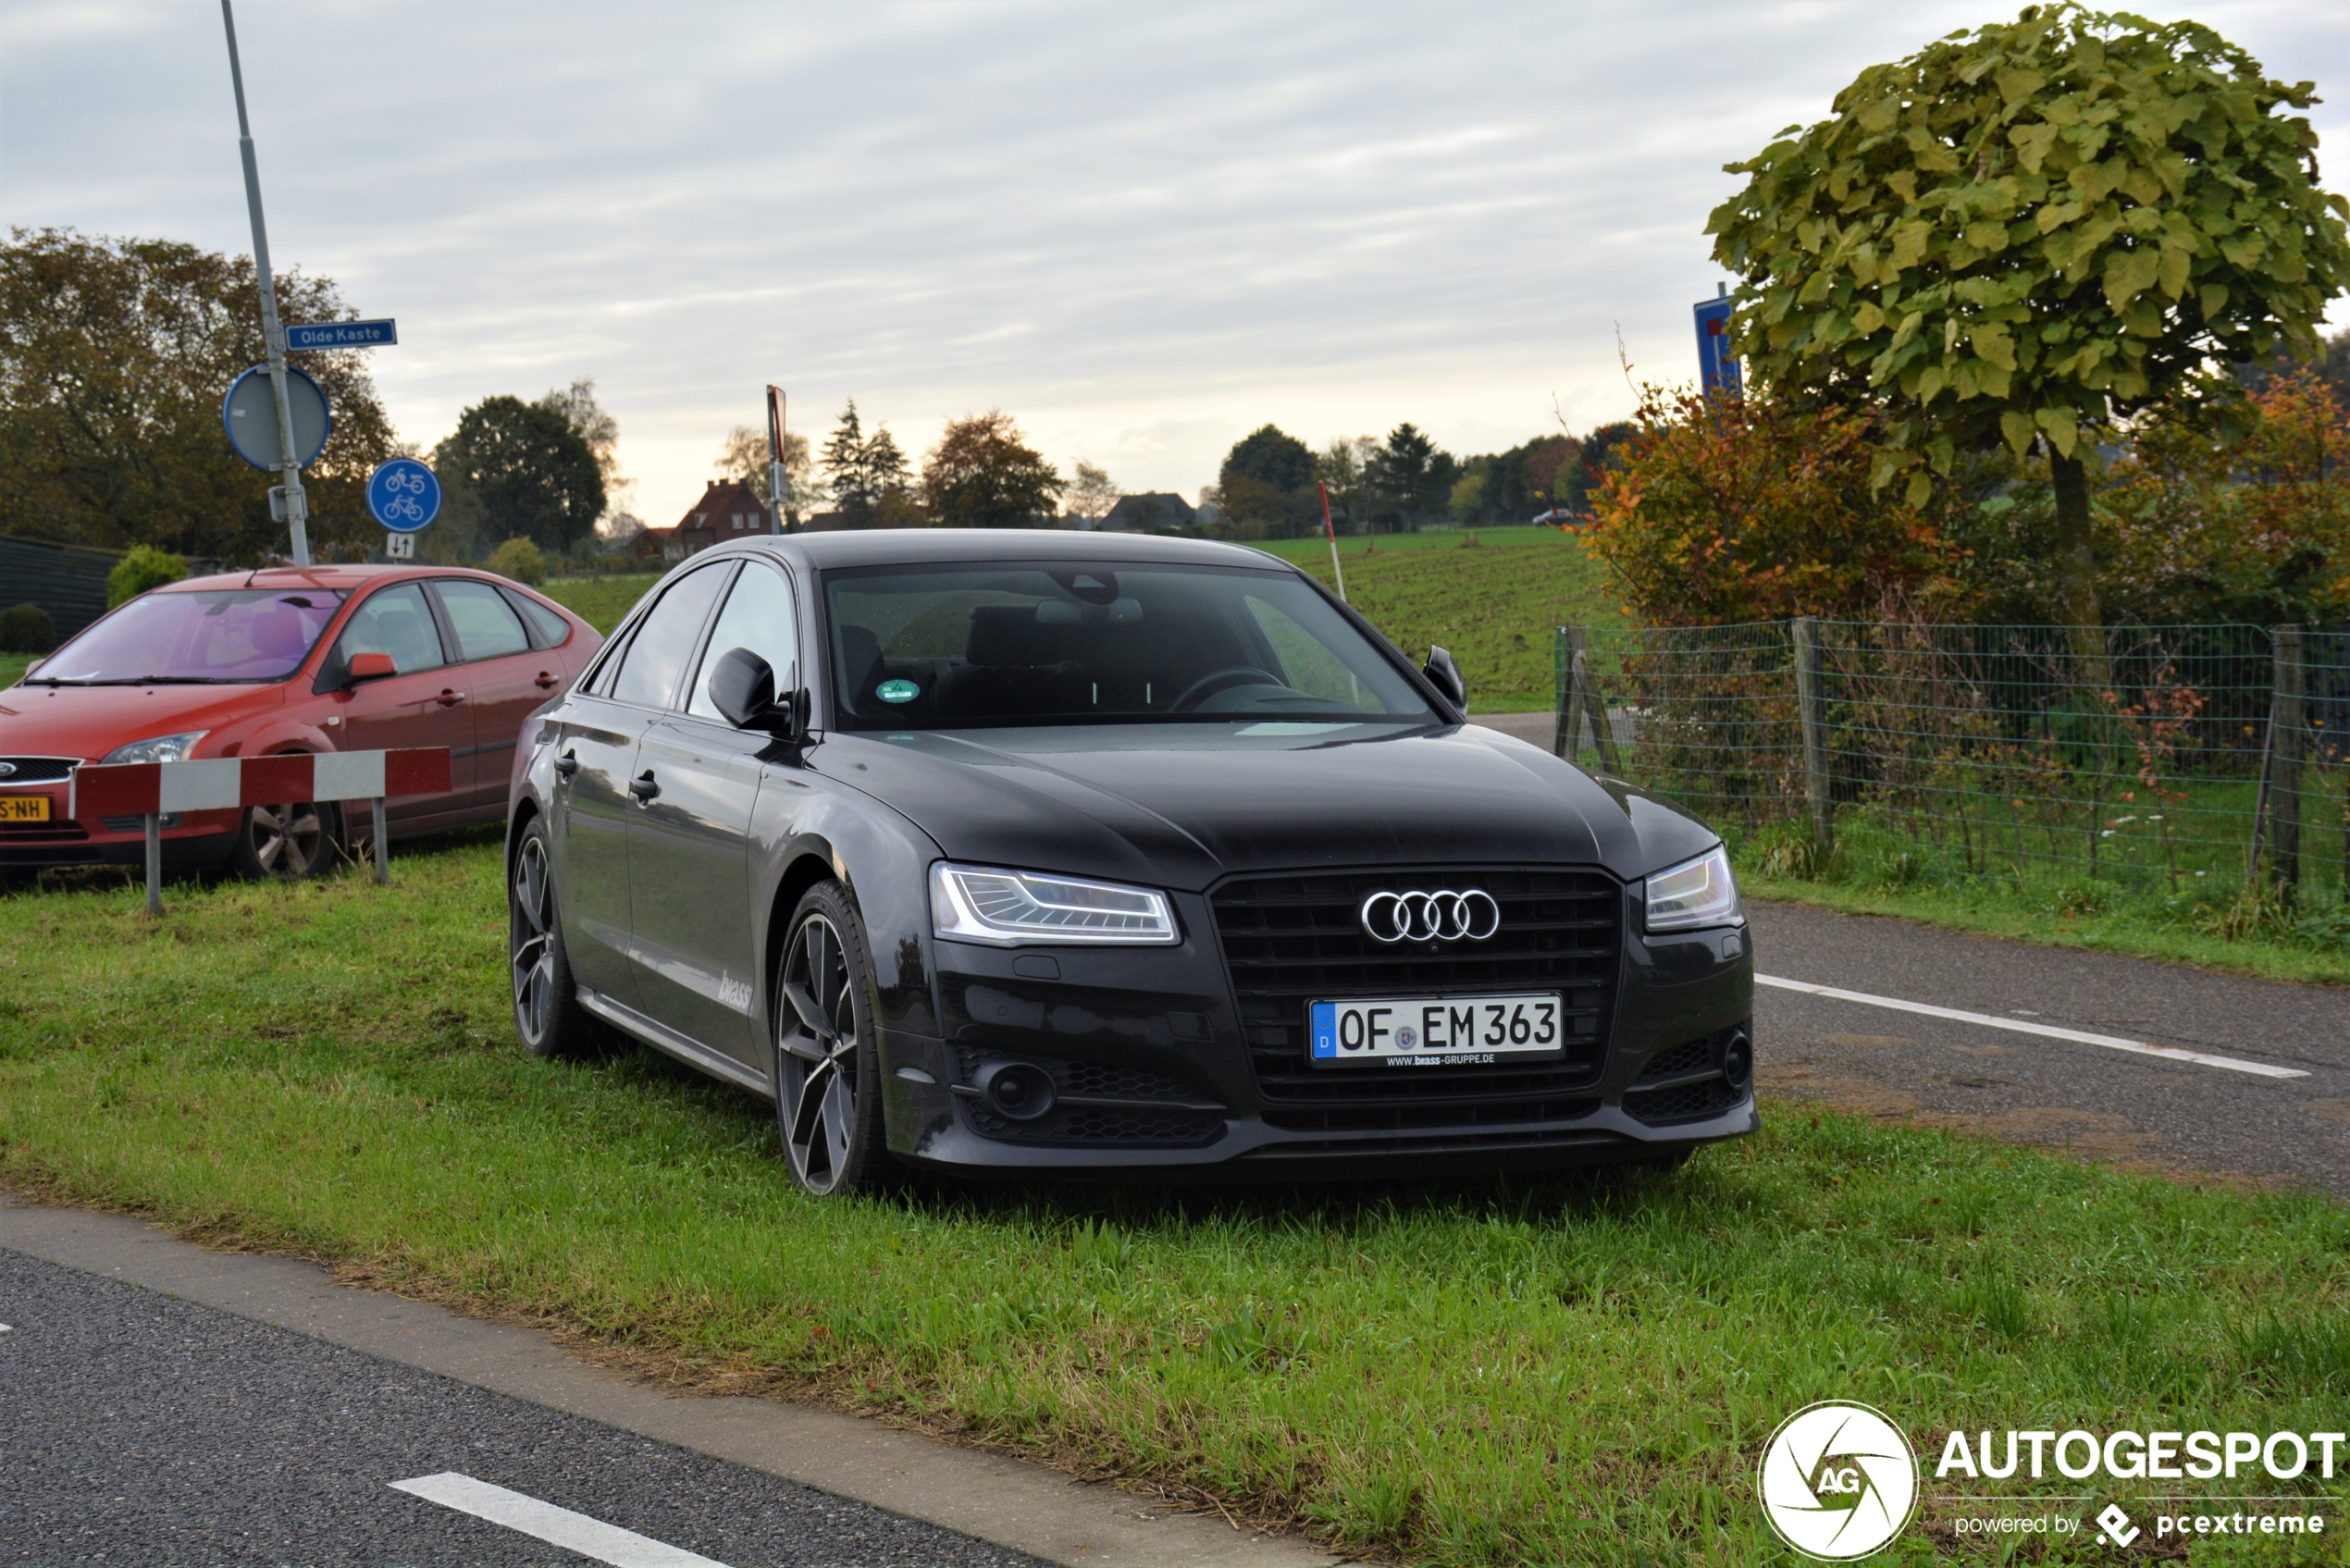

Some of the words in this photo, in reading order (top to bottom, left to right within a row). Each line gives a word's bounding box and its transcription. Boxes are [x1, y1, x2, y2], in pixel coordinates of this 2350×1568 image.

[301, 330, 333, 344] Olde
[336, 327, 380, 341] Kaste
[893, 683, 903, 691] 4
[1340, 1007, 1392, 1051] OF
[1423, 1006, 1475, 1048] EM
[1484, 1003, 1556, 1046] 363
[1319, 1037, 1330, 1048] D
[1387, 1054, 1495, 1067] WWW.brass-GRUPPE.DE
